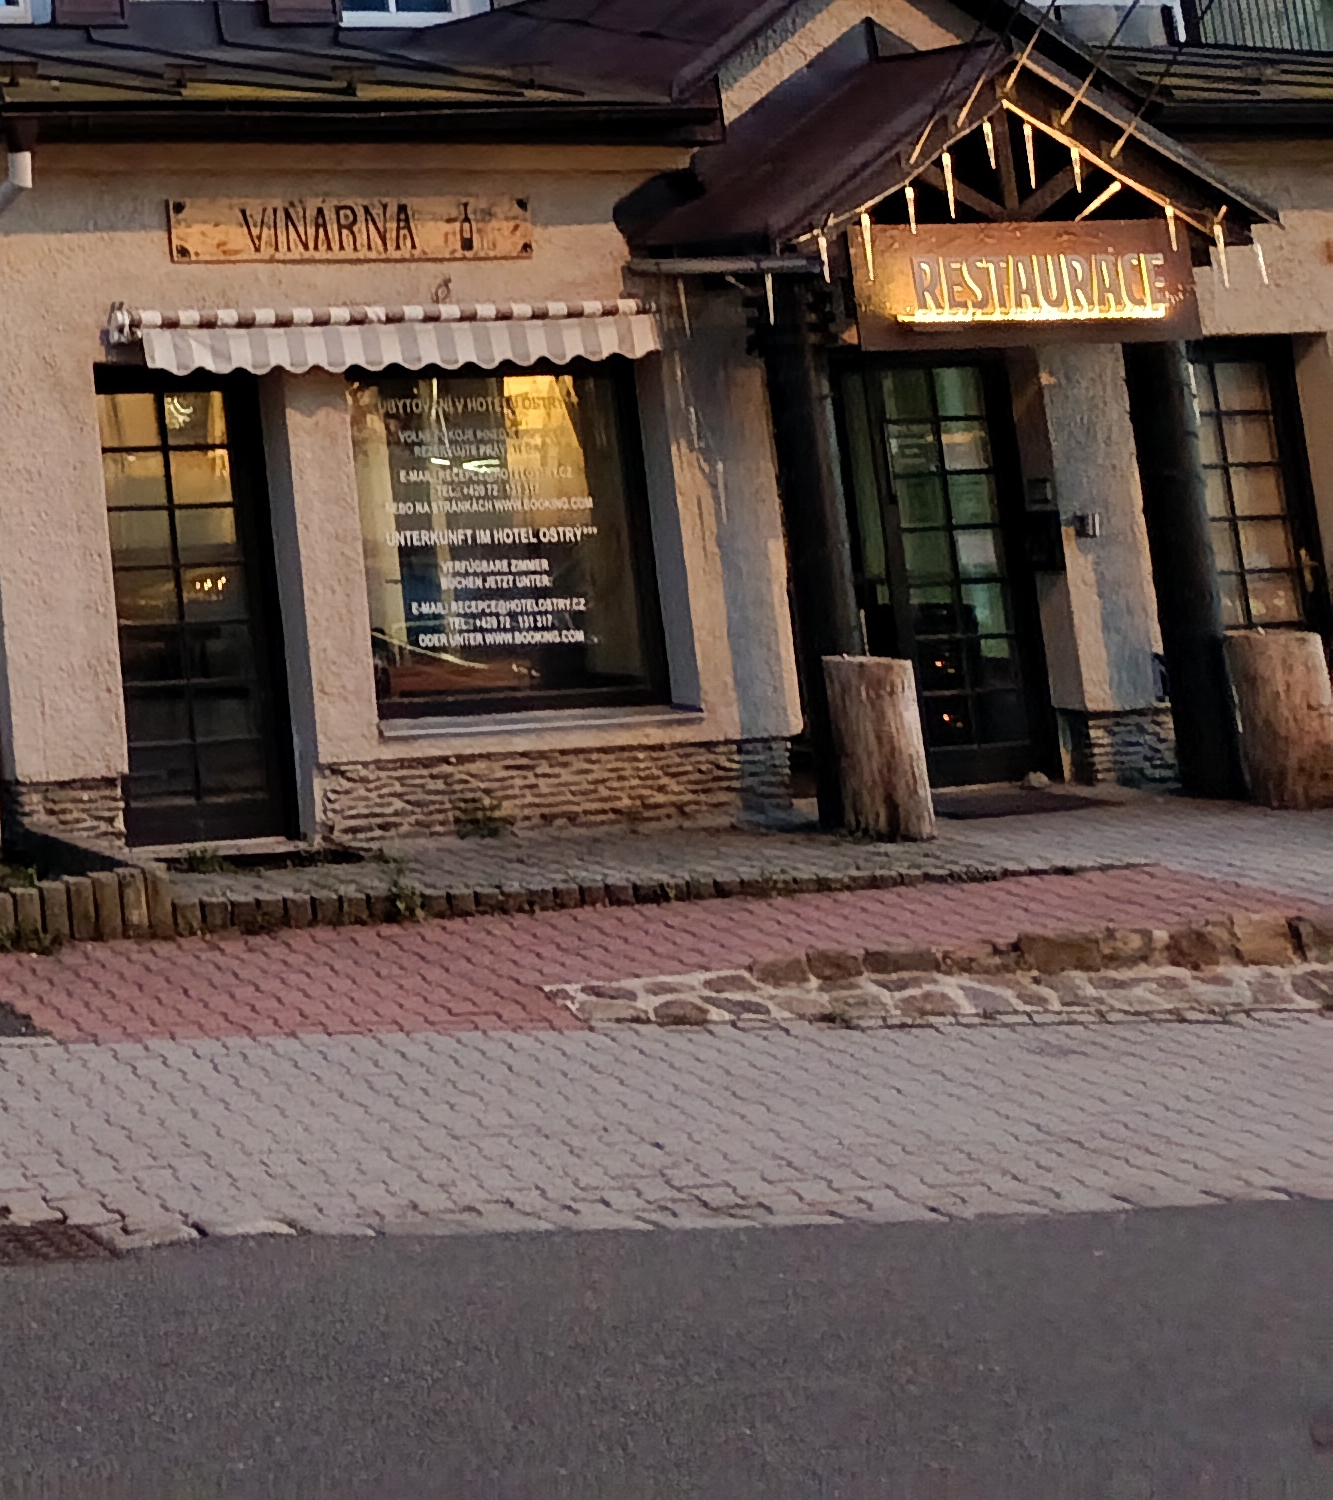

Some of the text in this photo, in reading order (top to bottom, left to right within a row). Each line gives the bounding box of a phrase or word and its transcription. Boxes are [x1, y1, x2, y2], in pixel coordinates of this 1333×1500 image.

[239, 199, 417, 253] VINÁRNA
[909, 252, 1165, 315] RESTAURACE
[386, 529, 473, 547] UNTERKUNFT
[475, 530, 491, 544] IM
[493, 527, 538, 544] HOTEL
